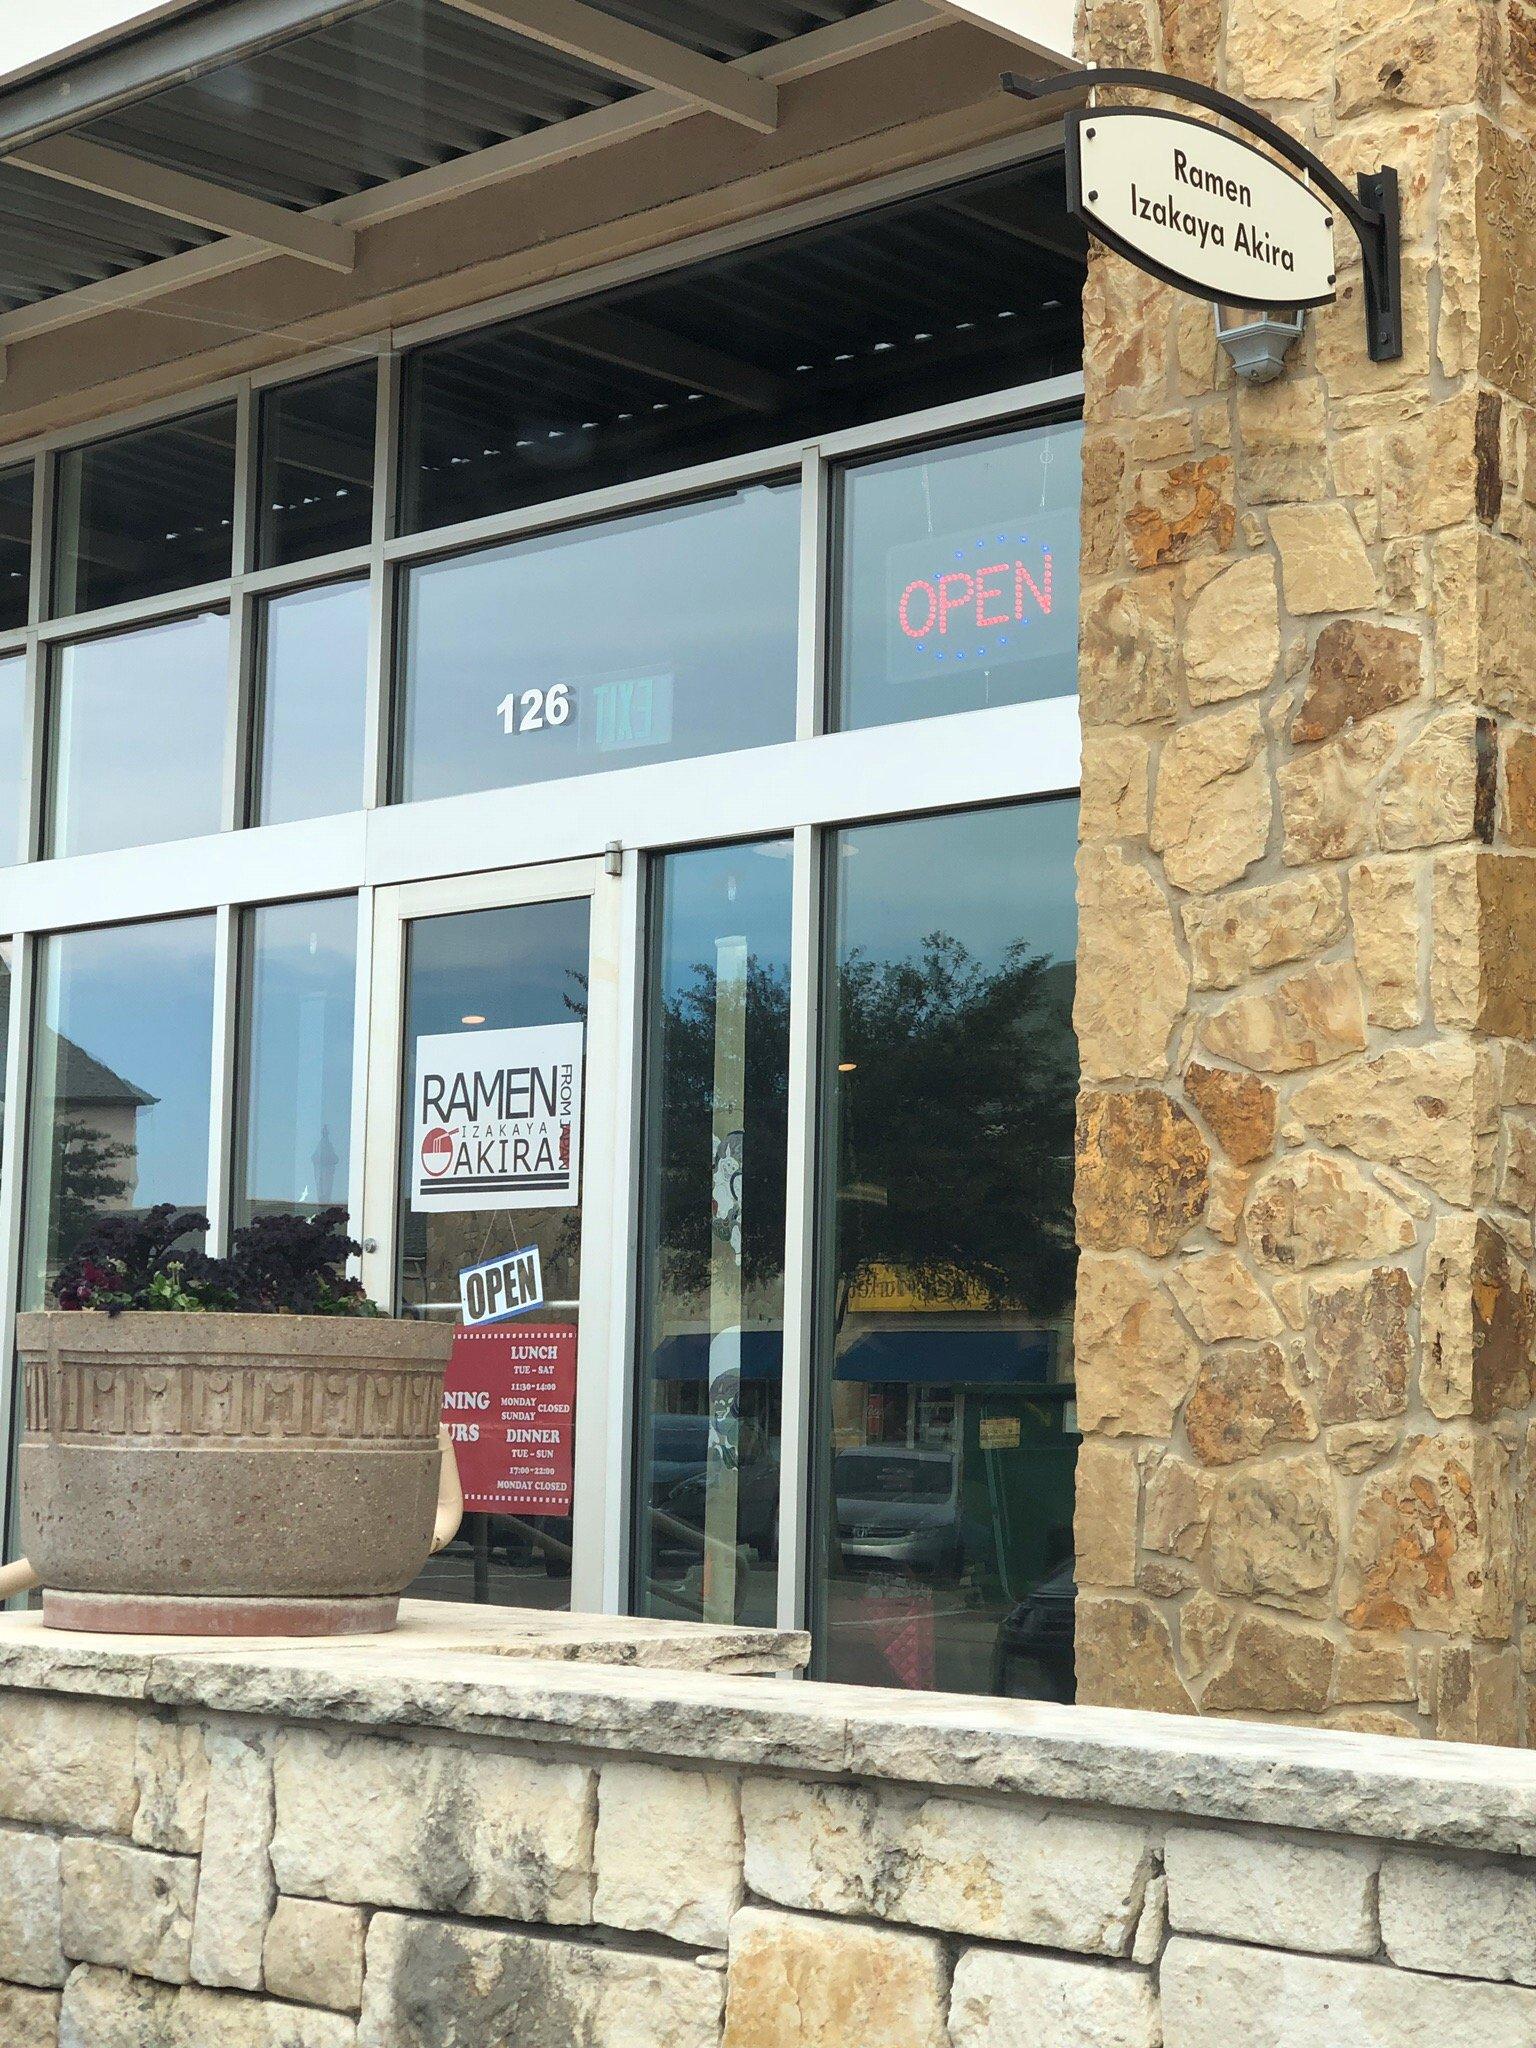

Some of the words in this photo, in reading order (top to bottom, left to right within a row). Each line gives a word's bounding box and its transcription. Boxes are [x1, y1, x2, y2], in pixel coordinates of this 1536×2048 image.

[1174, 148, 1252, 207] Ramen
[1131, 183, 1224, 249] Izakaya
[1234, 222, 1294, 272] Akira
[899, 554, 1053, 638] OPEN
[496, 683, 569, 734] 126
[422, 1065, 558, 1125] RAMEN
[560, 1064, 572, 1116] FROM
[462, 1121, 547, 1138] IZAKAYA
[559, 1120, 572, 1170] JAPAN
[453, 1137, 555, 1175] AKIRA
[466, 1255, 537, 1320] OPEN
[510, 1346, 558, 1359] LUNCH
[513, 1366, 531, 1374] TUE
[538, 1366, 554, 1374] SAT
[442, 1391, 491, 1410] NING
[501, 1397, 537, 1406] MONDAY
[537, 1404, 570, 1413] CLOSED
[501, 1412, 536, 1421] SUNDAY
[506, 1428, 561, 1443] DINNER
[511, 1449, 529, 1458] TUE
[536, 1449, 554, 1458] SUN
[497, 1480, 534, 1490] MONDAY
[534, 1482, 568, 1491] CLOSED
